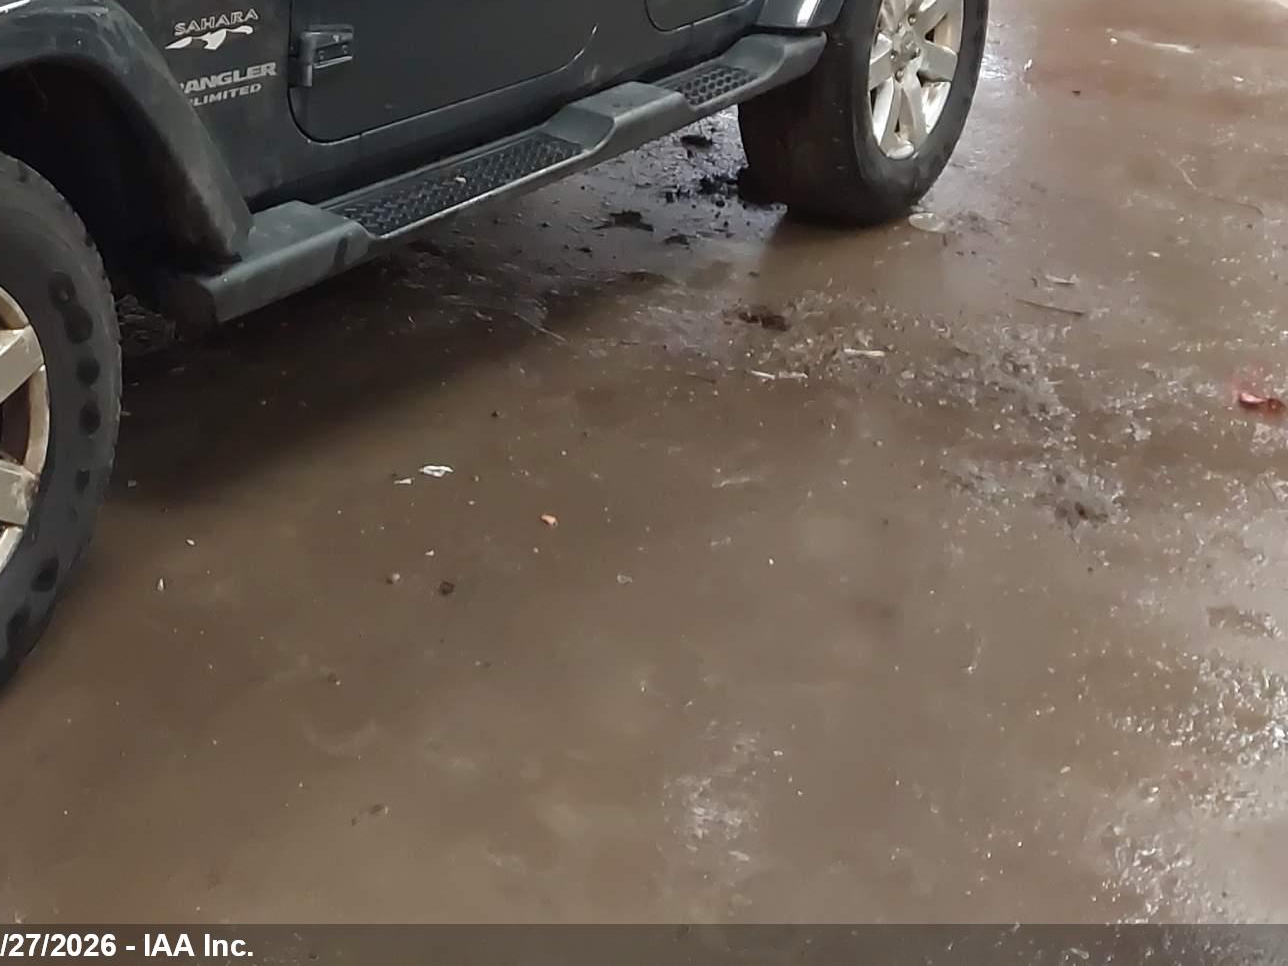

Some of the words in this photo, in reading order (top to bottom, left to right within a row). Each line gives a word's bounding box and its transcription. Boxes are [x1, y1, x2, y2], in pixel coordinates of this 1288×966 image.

[174, 9, 259, 36] SAHARA
[180, 62, 277, 94] ANGLER
[190, 83, 262, 106] LIMITED
